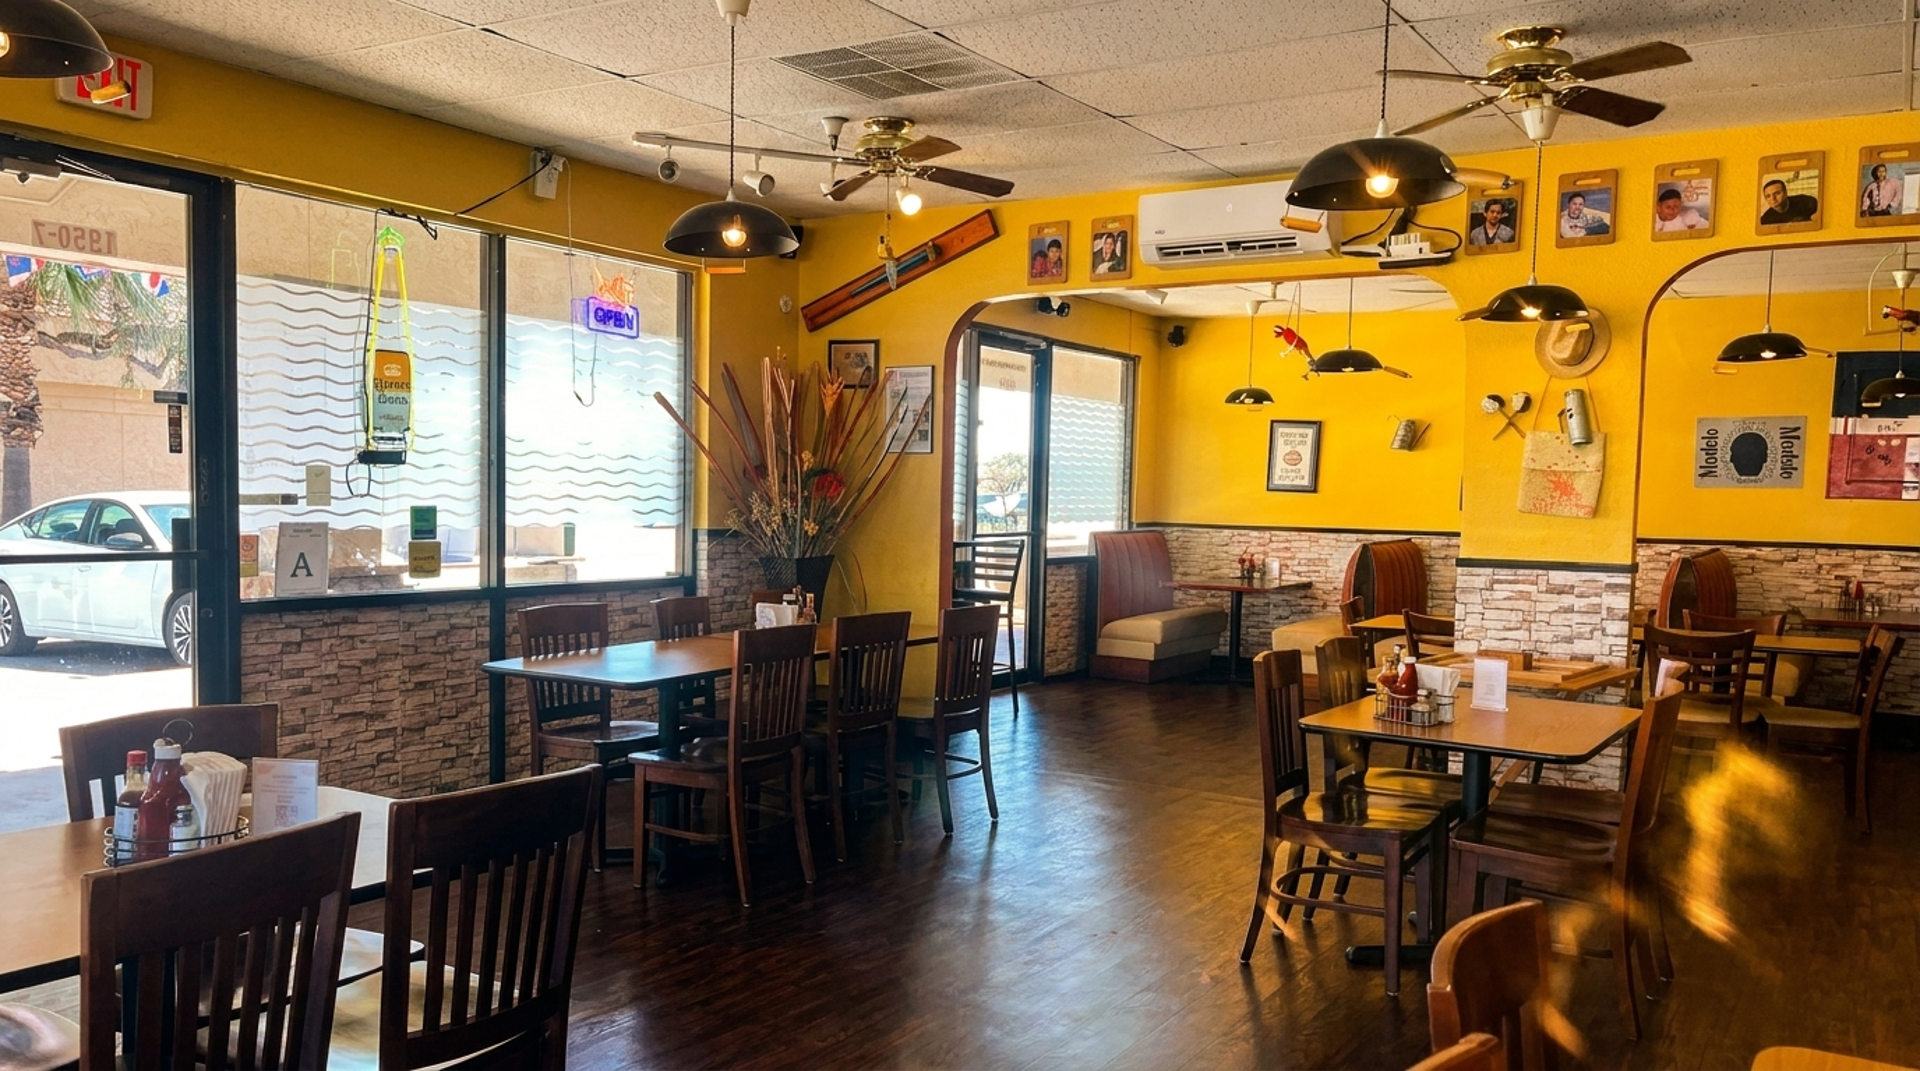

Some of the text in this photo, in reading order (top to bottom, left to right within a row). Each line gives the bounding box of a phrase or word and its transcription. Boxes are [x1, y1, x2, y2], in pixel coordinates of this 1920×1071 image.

[1698, 428, 1719, 478] Modelo
[1779, 426, 1801, 480] Modelo
[290, 552, 314, 578] A
